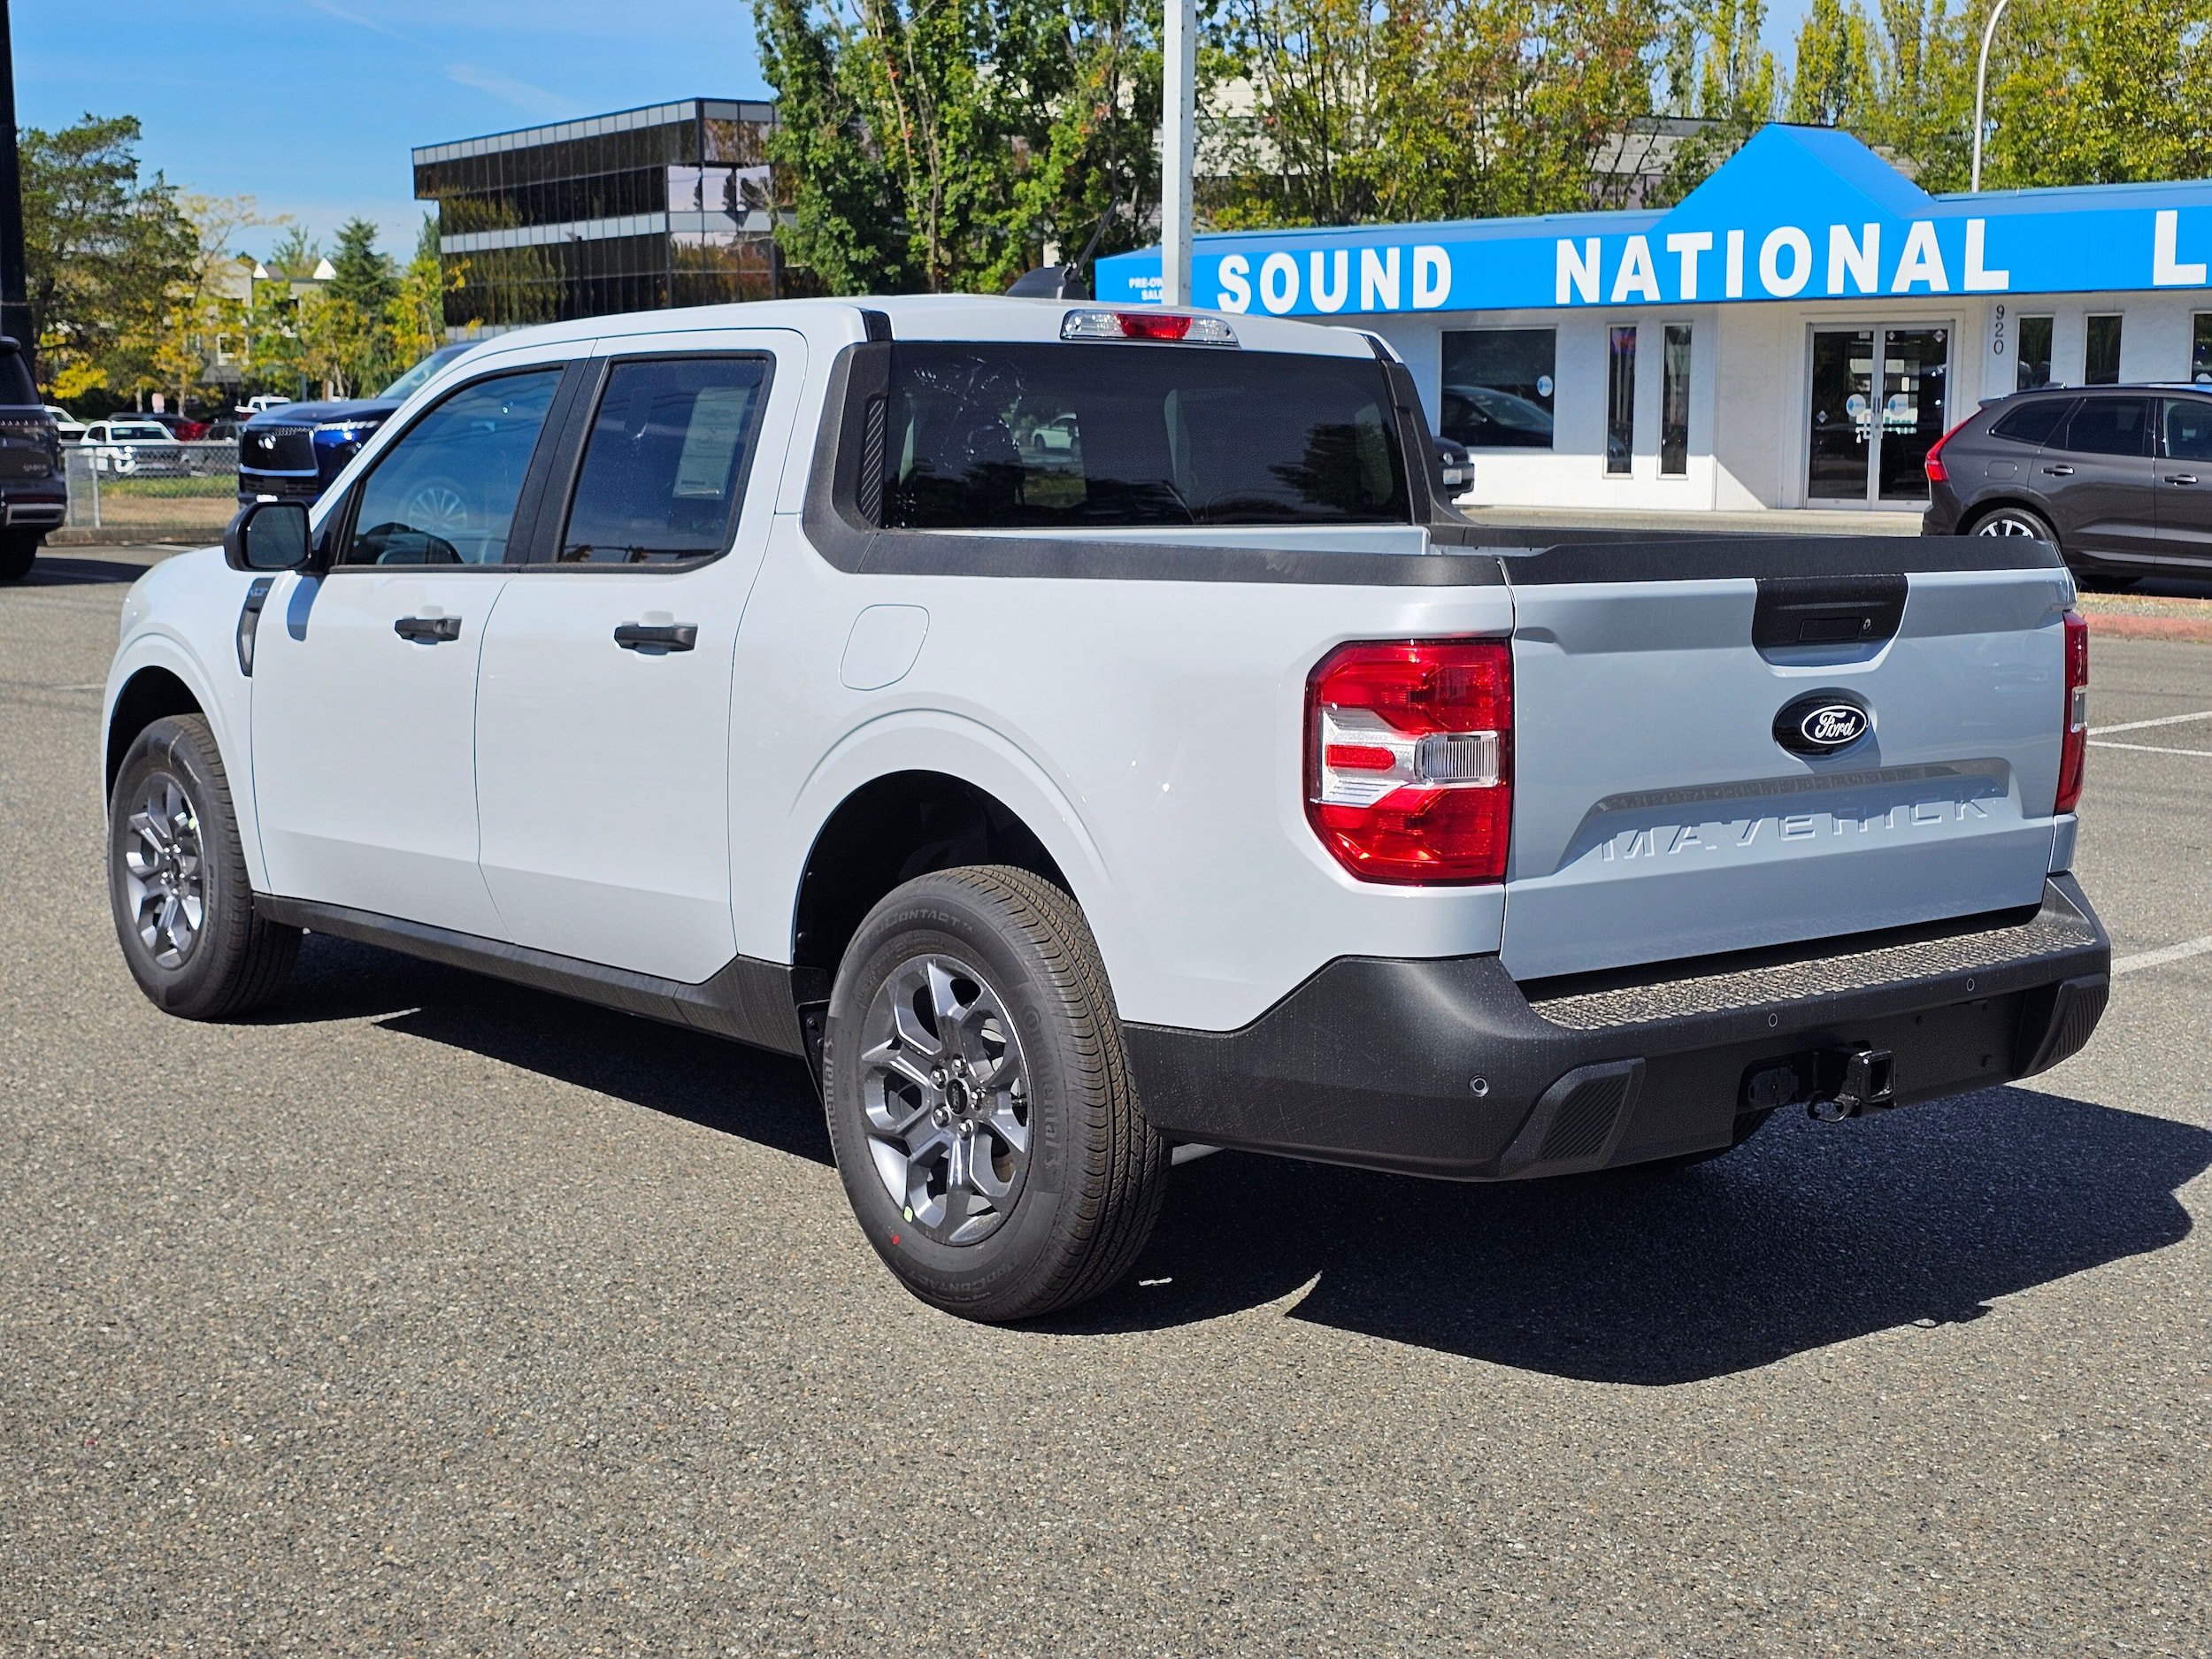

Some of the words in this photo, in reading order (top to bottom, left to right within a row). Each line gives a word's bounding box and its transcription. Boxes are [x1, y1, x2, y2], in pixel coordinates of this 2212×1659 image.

[1217, 244, 1452, 314] SOUND
[1555, 219, 2009, 305] NATIONAL
[1993, 304, 2005, 356] 920
[1814, 710, 1855, 739] Ford
[1601, 788, 1989, 862] MAVERICK
